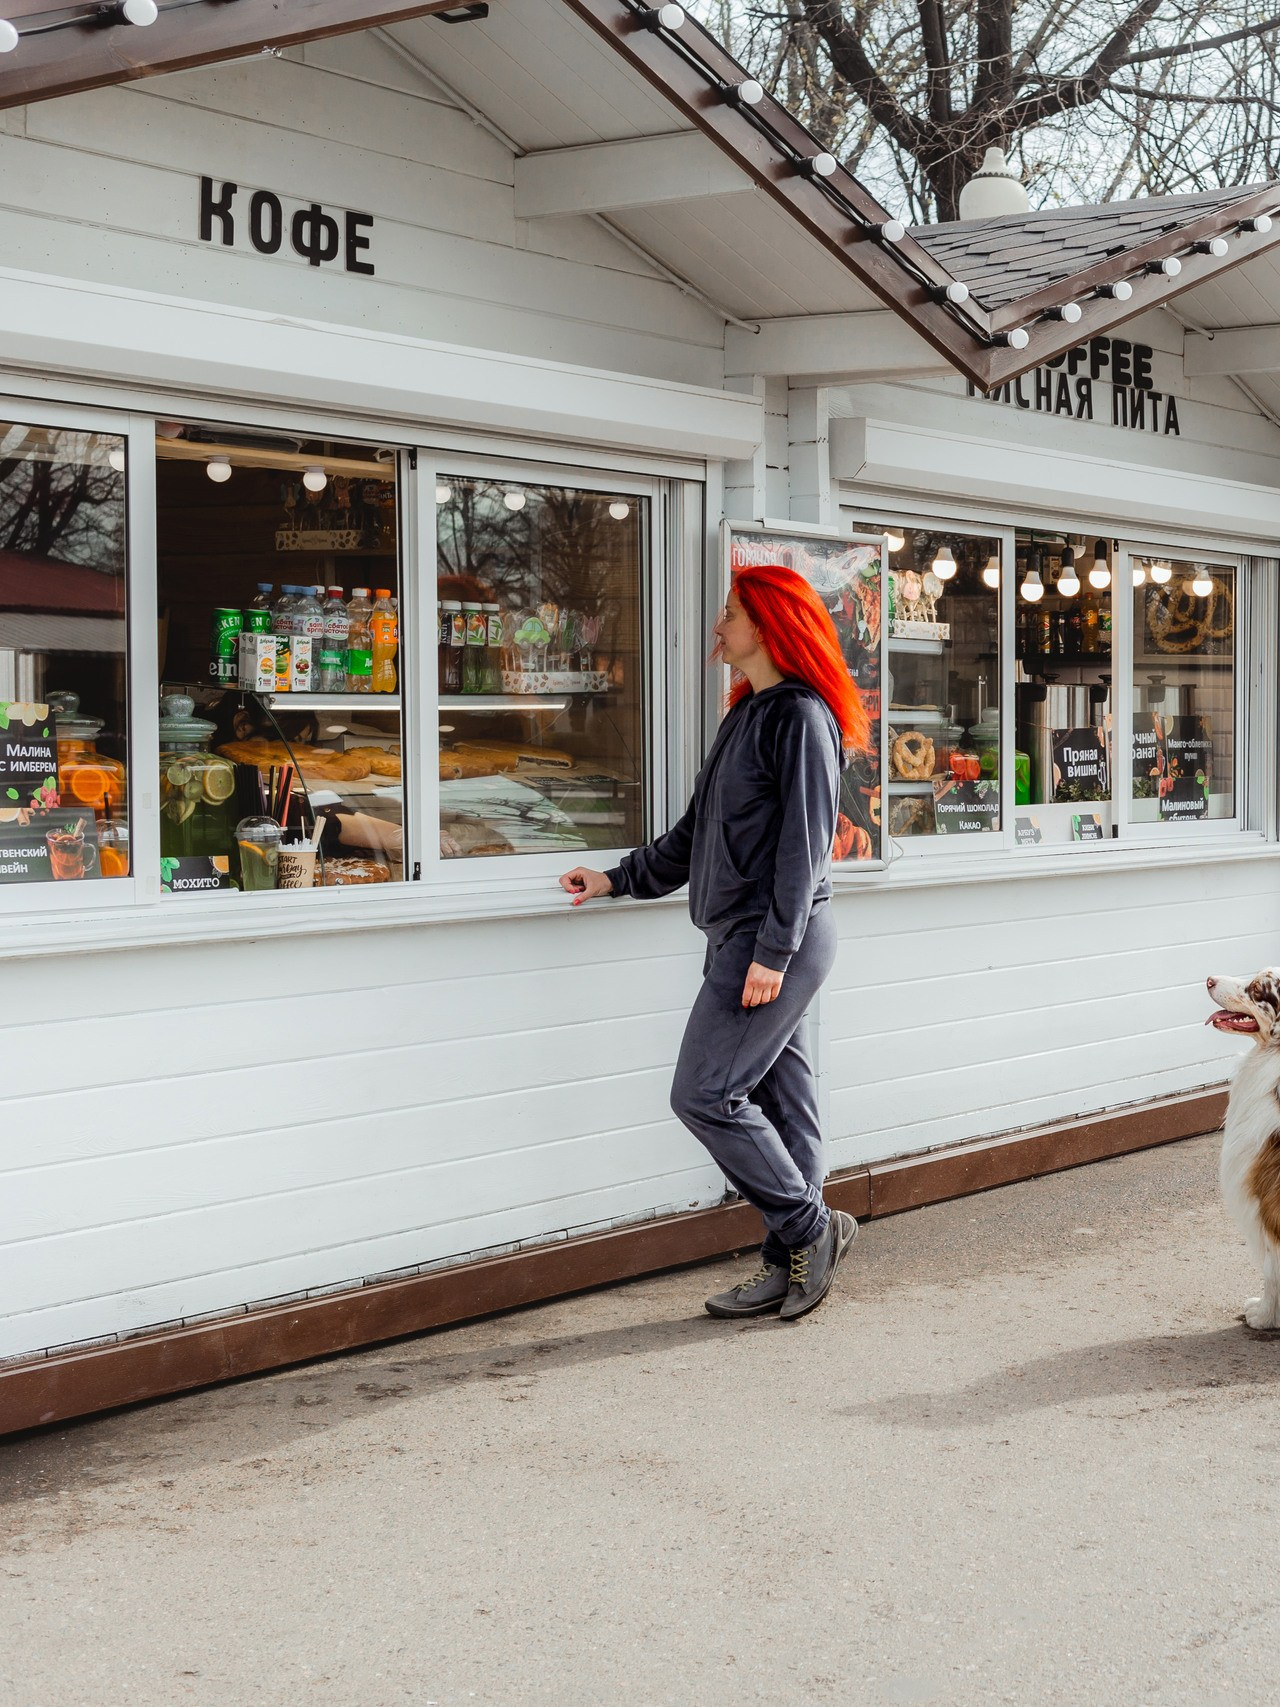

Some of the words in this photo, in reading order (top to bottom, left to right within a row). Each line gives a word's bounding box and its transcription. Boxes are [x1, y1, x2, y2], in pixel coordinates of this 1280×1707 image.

[199, 175, 375, 276] КОФЕ
[966, 368, 1094, 420] СНАЯ
[1112, 384, 1180, 436] ПИТА
[1063, 747, 1098, 765] Пряная
[10, 761, 57, 773] ИМБЕРЕМ
[1067, 765, 1098, 777] вишня
[1162, 798, 1204, 812] Малиновый
[172, 877, 220, 889] МОХИТО
